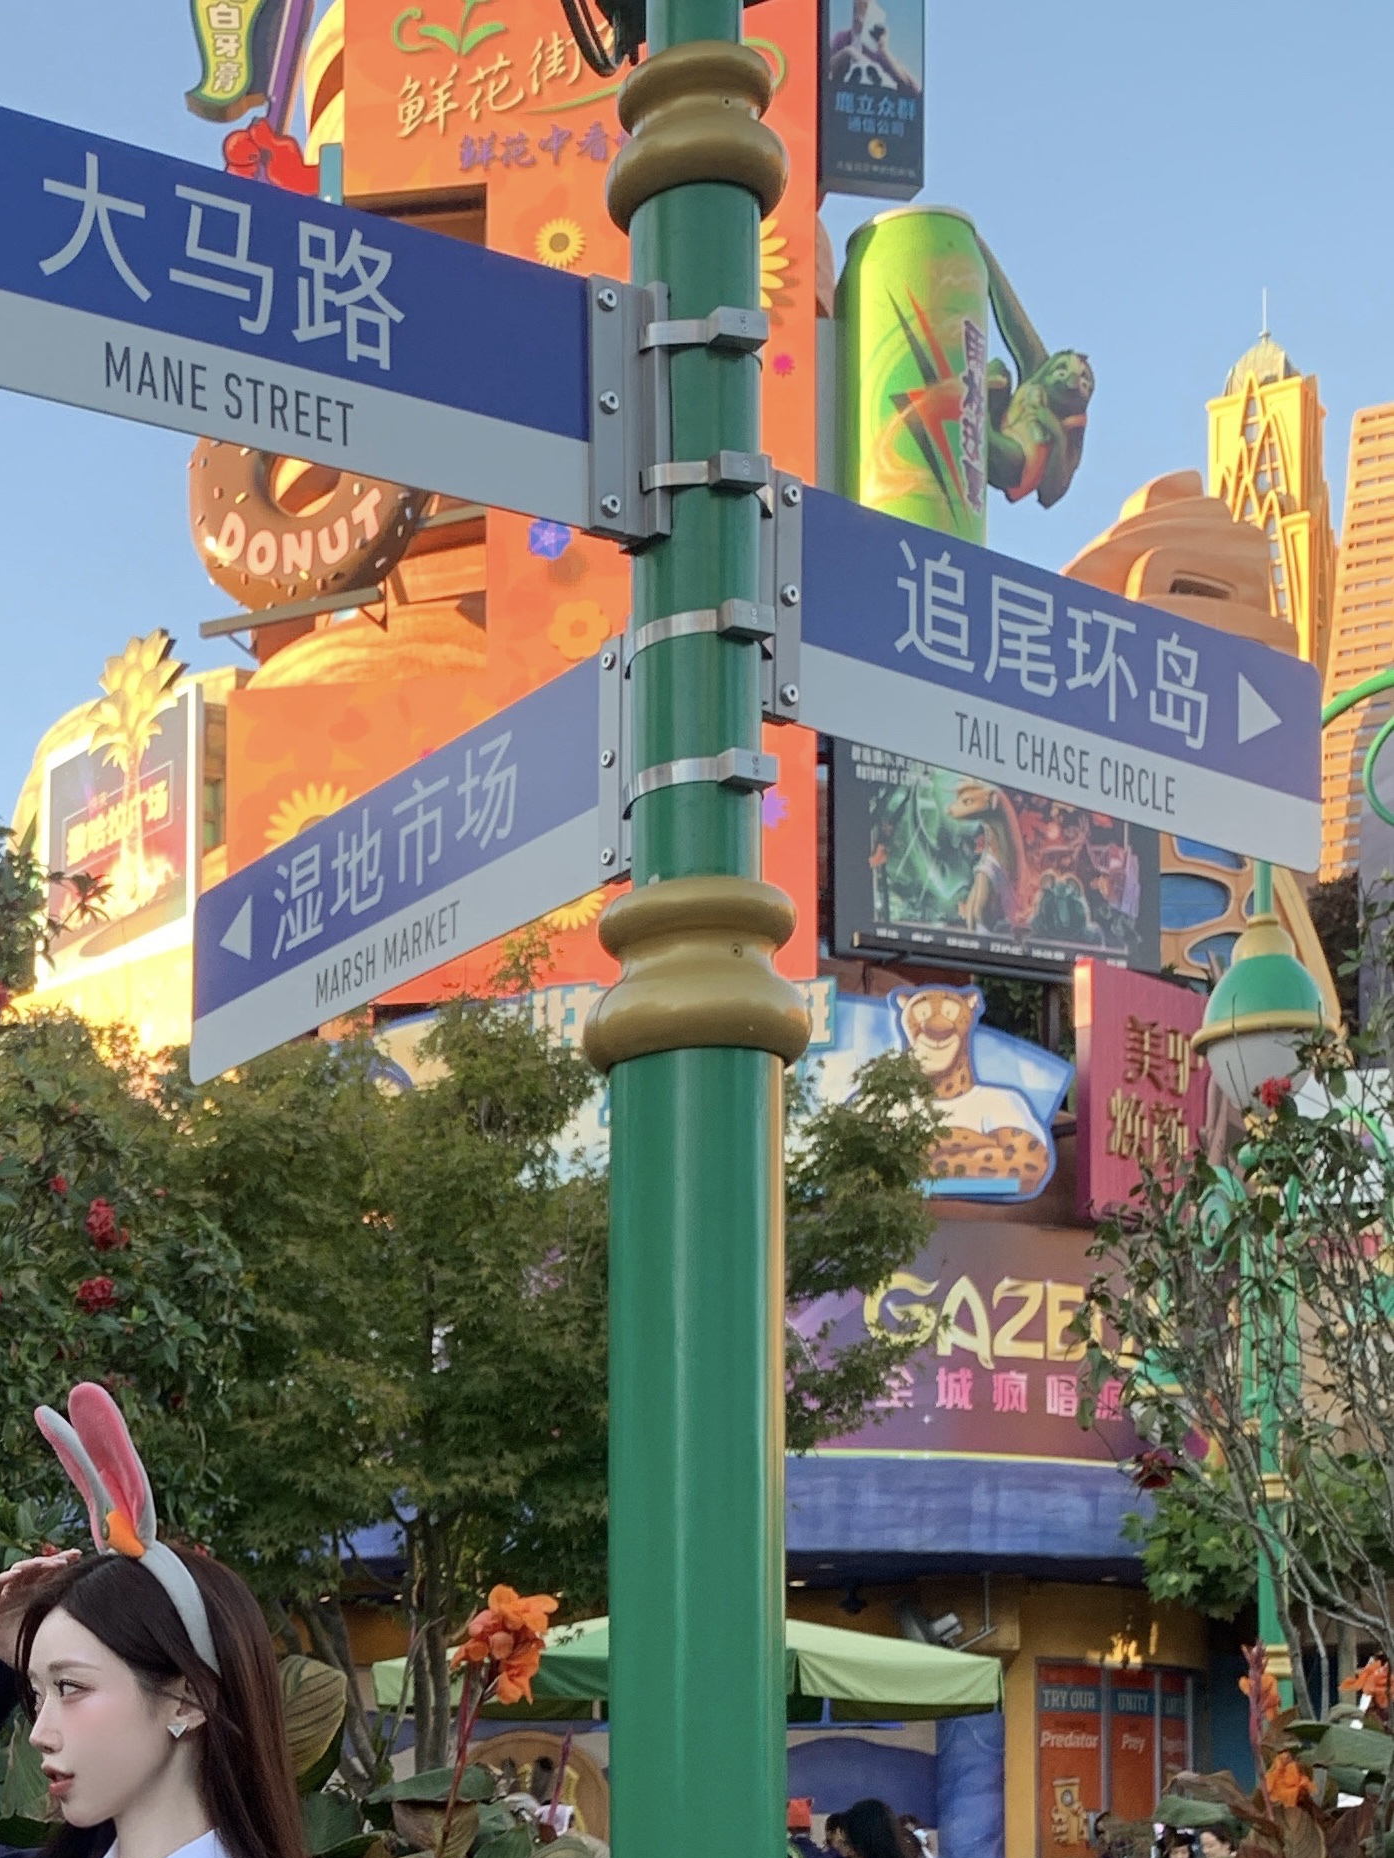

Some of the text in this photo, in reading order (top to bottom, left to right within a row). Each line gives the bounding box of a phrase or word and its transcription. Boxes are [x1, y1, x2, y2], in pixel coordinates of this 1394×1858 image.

[207, 0, 243, 93] 白牙膏
[396, 20, 614, 138] 鲜花街
[458, 120, 632, 171] 鲜花中看
[39, 151, 405, 370] 大马路
[105, 341, 354, 447] MANE STREET
[216, 488, 383, 576] DONUT
[893, 539, 1208, 750] 追尾环岛
[954, 711, 1005, 765] TAIL
[1016, 731, 1090, 790] CHASE
[1100, 756, 1176, 815] CIRCLE
[271, 730, 517, 961] 湿地市场
[315, 899, 460, 1008] MARSH MARKET
[1040, 1730, 1100, 1749] Predator
